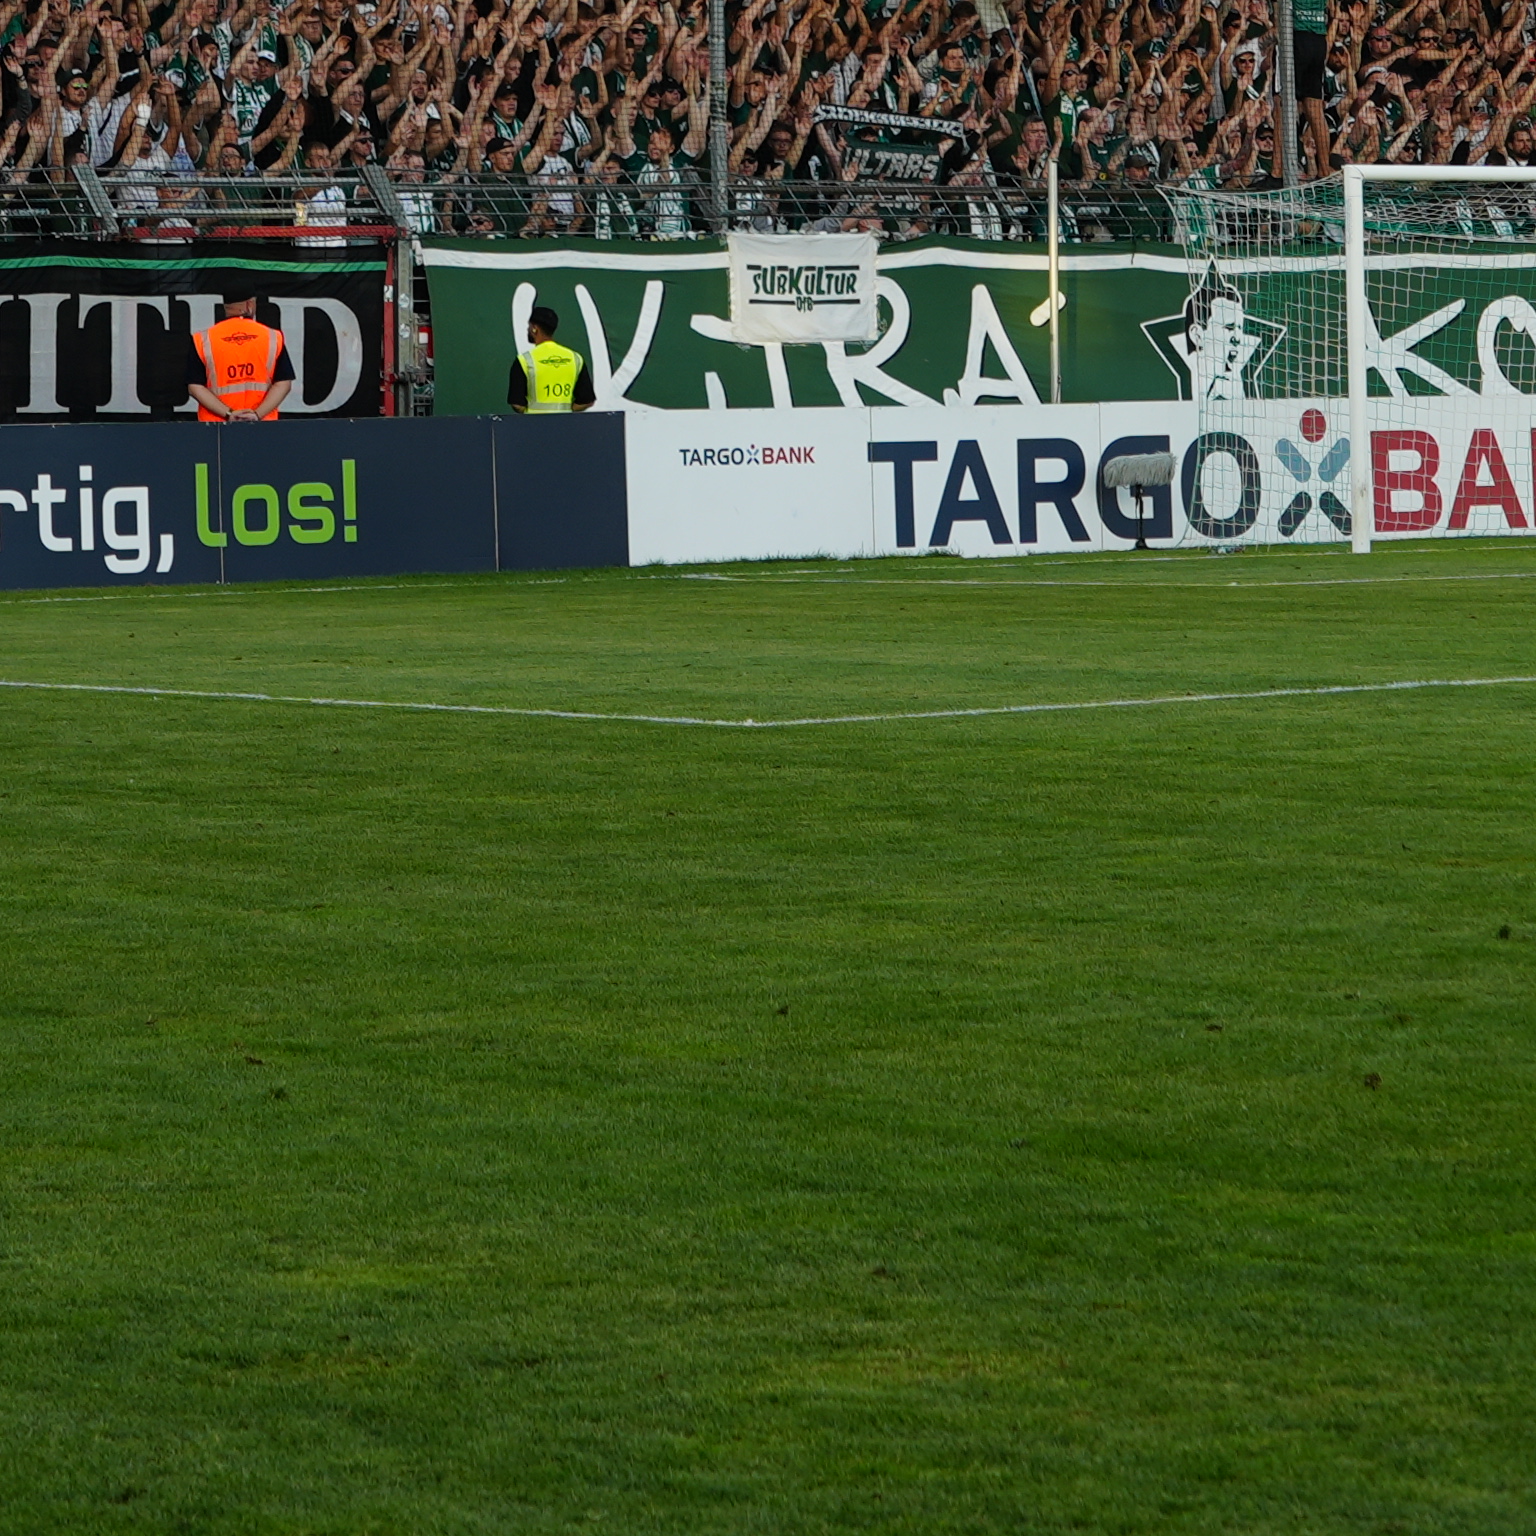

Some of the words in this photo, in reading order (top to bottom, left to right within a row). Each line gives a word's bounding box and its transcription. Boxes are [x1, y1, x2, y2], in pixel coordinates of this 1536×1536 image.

[227, 363, 254, 378] 070
[544, 383, 571, 397] 108
[195, 459, 357, 547] los!
